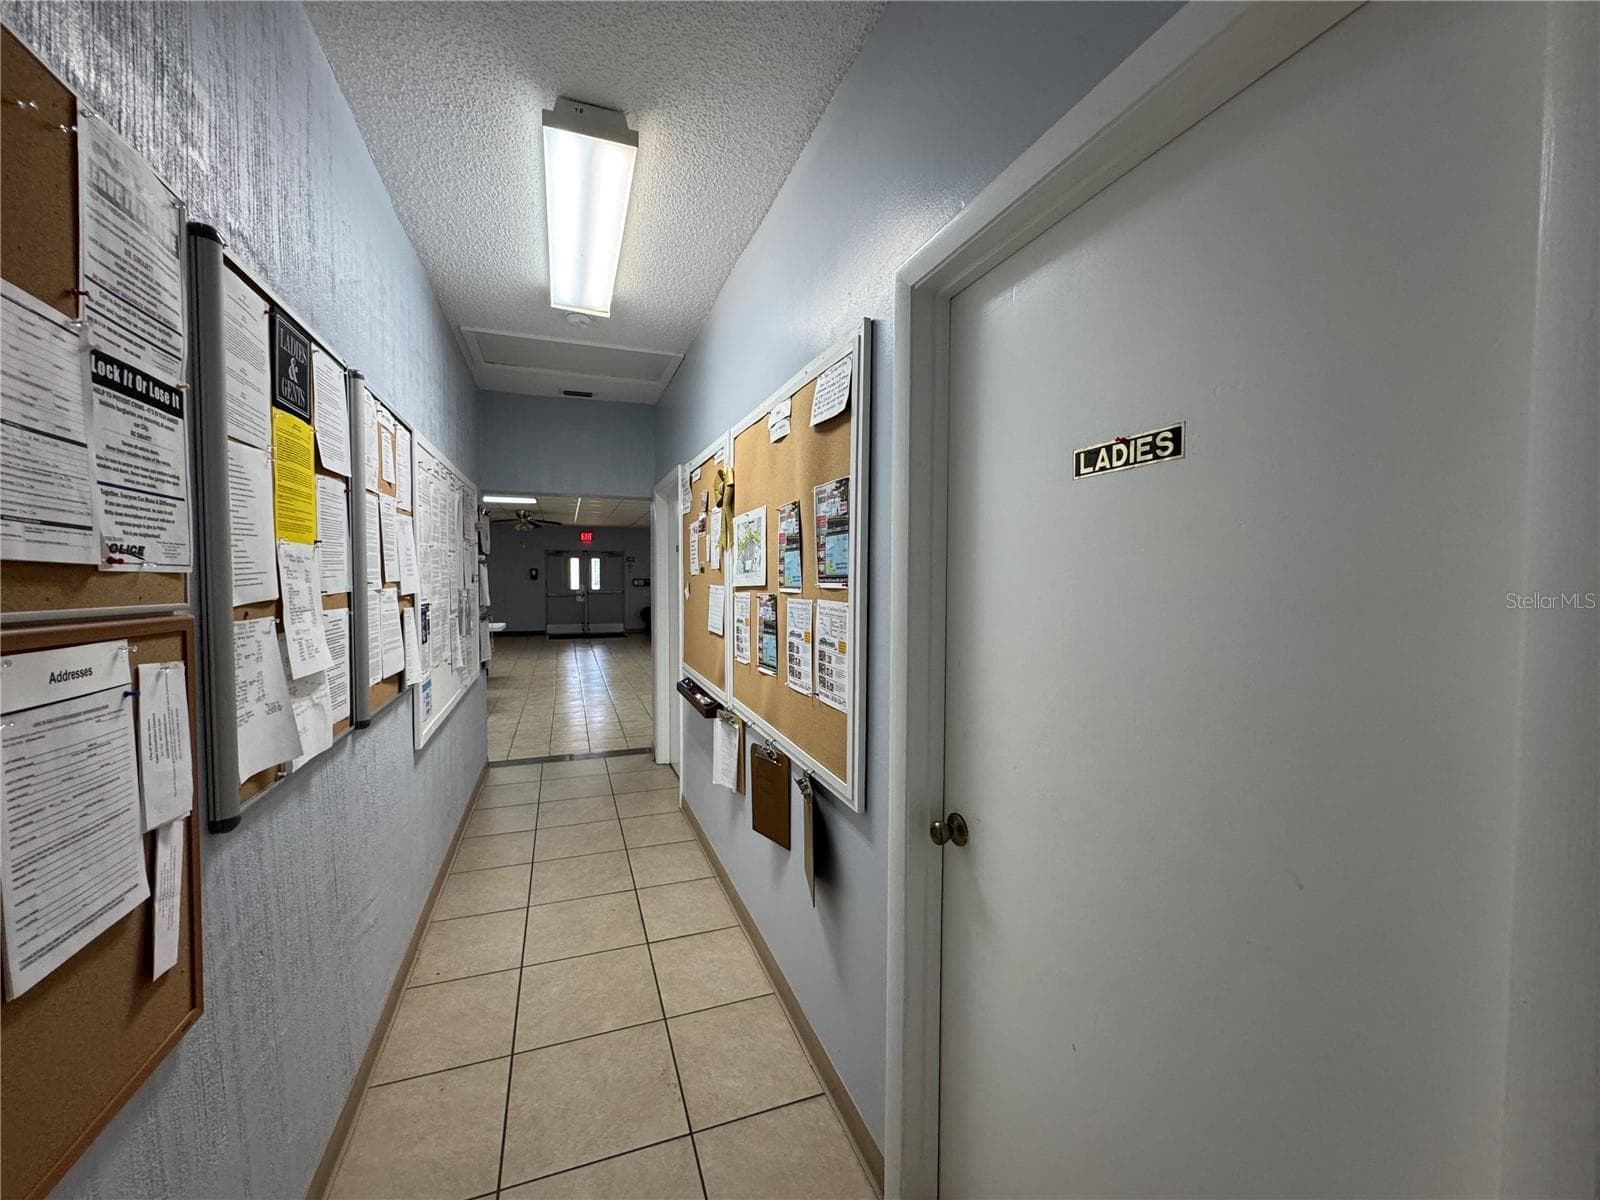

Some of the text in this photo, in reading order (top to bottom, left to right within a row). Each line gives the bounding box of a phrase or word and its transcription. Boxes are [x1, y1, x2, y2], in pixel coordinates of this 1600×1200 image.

[280, 327, 307, 366] LADIES
[91, 354, 180, 409] Lock It Or Lose It
[1080, 430, 1174, 474] LADIES
[107, 543, 145, 556] OLICE
[48, 667, 93, 684] Addresses
